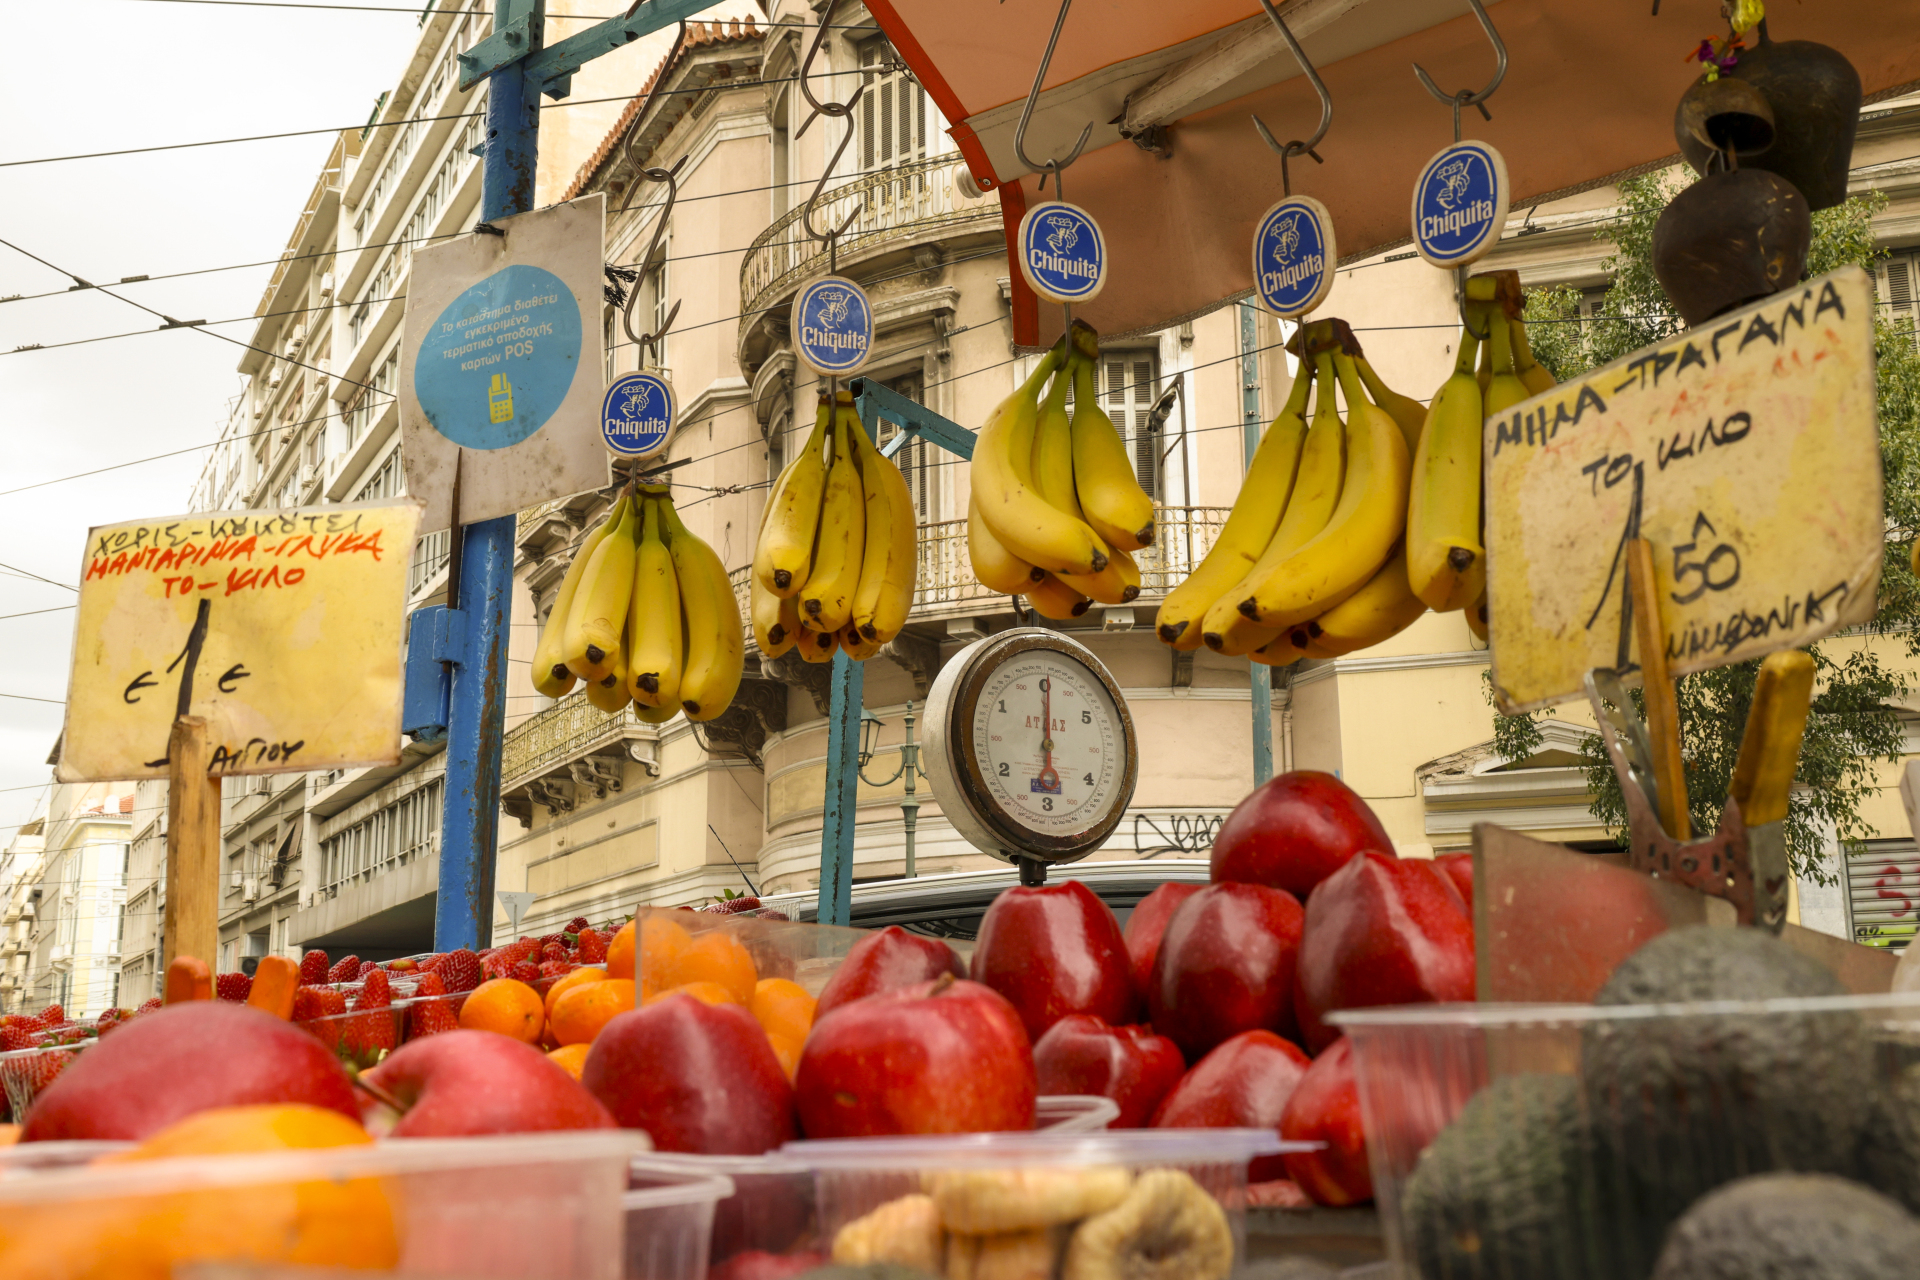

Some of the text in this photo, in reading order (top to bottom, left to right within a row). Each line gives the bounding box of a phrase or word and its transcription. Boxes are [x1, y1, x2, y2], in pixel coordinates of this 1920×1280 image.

[1421, 199, 1493, 241] Chiquita
[1030, 248, 1098, 280] Chiquita
[1262, 253, 1324, 296] Chiquita
[441, 322, 453, 333] Το
[514, 294, 558, 311] διαθέτει
[464, 314, 529, 339] εγκεκριμένο
[442, 322, 553, 359] τερματικό αποδοχής
[802, 326, 867, 354] Chiquita
[461, 340, 534, 371] καρτών POS
[605, 417, 667, 440] Chiquita
[1039, 678, 1051, 693] 0
[998, 699, 1007, 713] 1
[1081, 710, 1092, 724] 5
[999, 762, 1010, 777] 2
[1083, 772, 1094, 786] 4
[1042, 796, 1053, 811] 3
